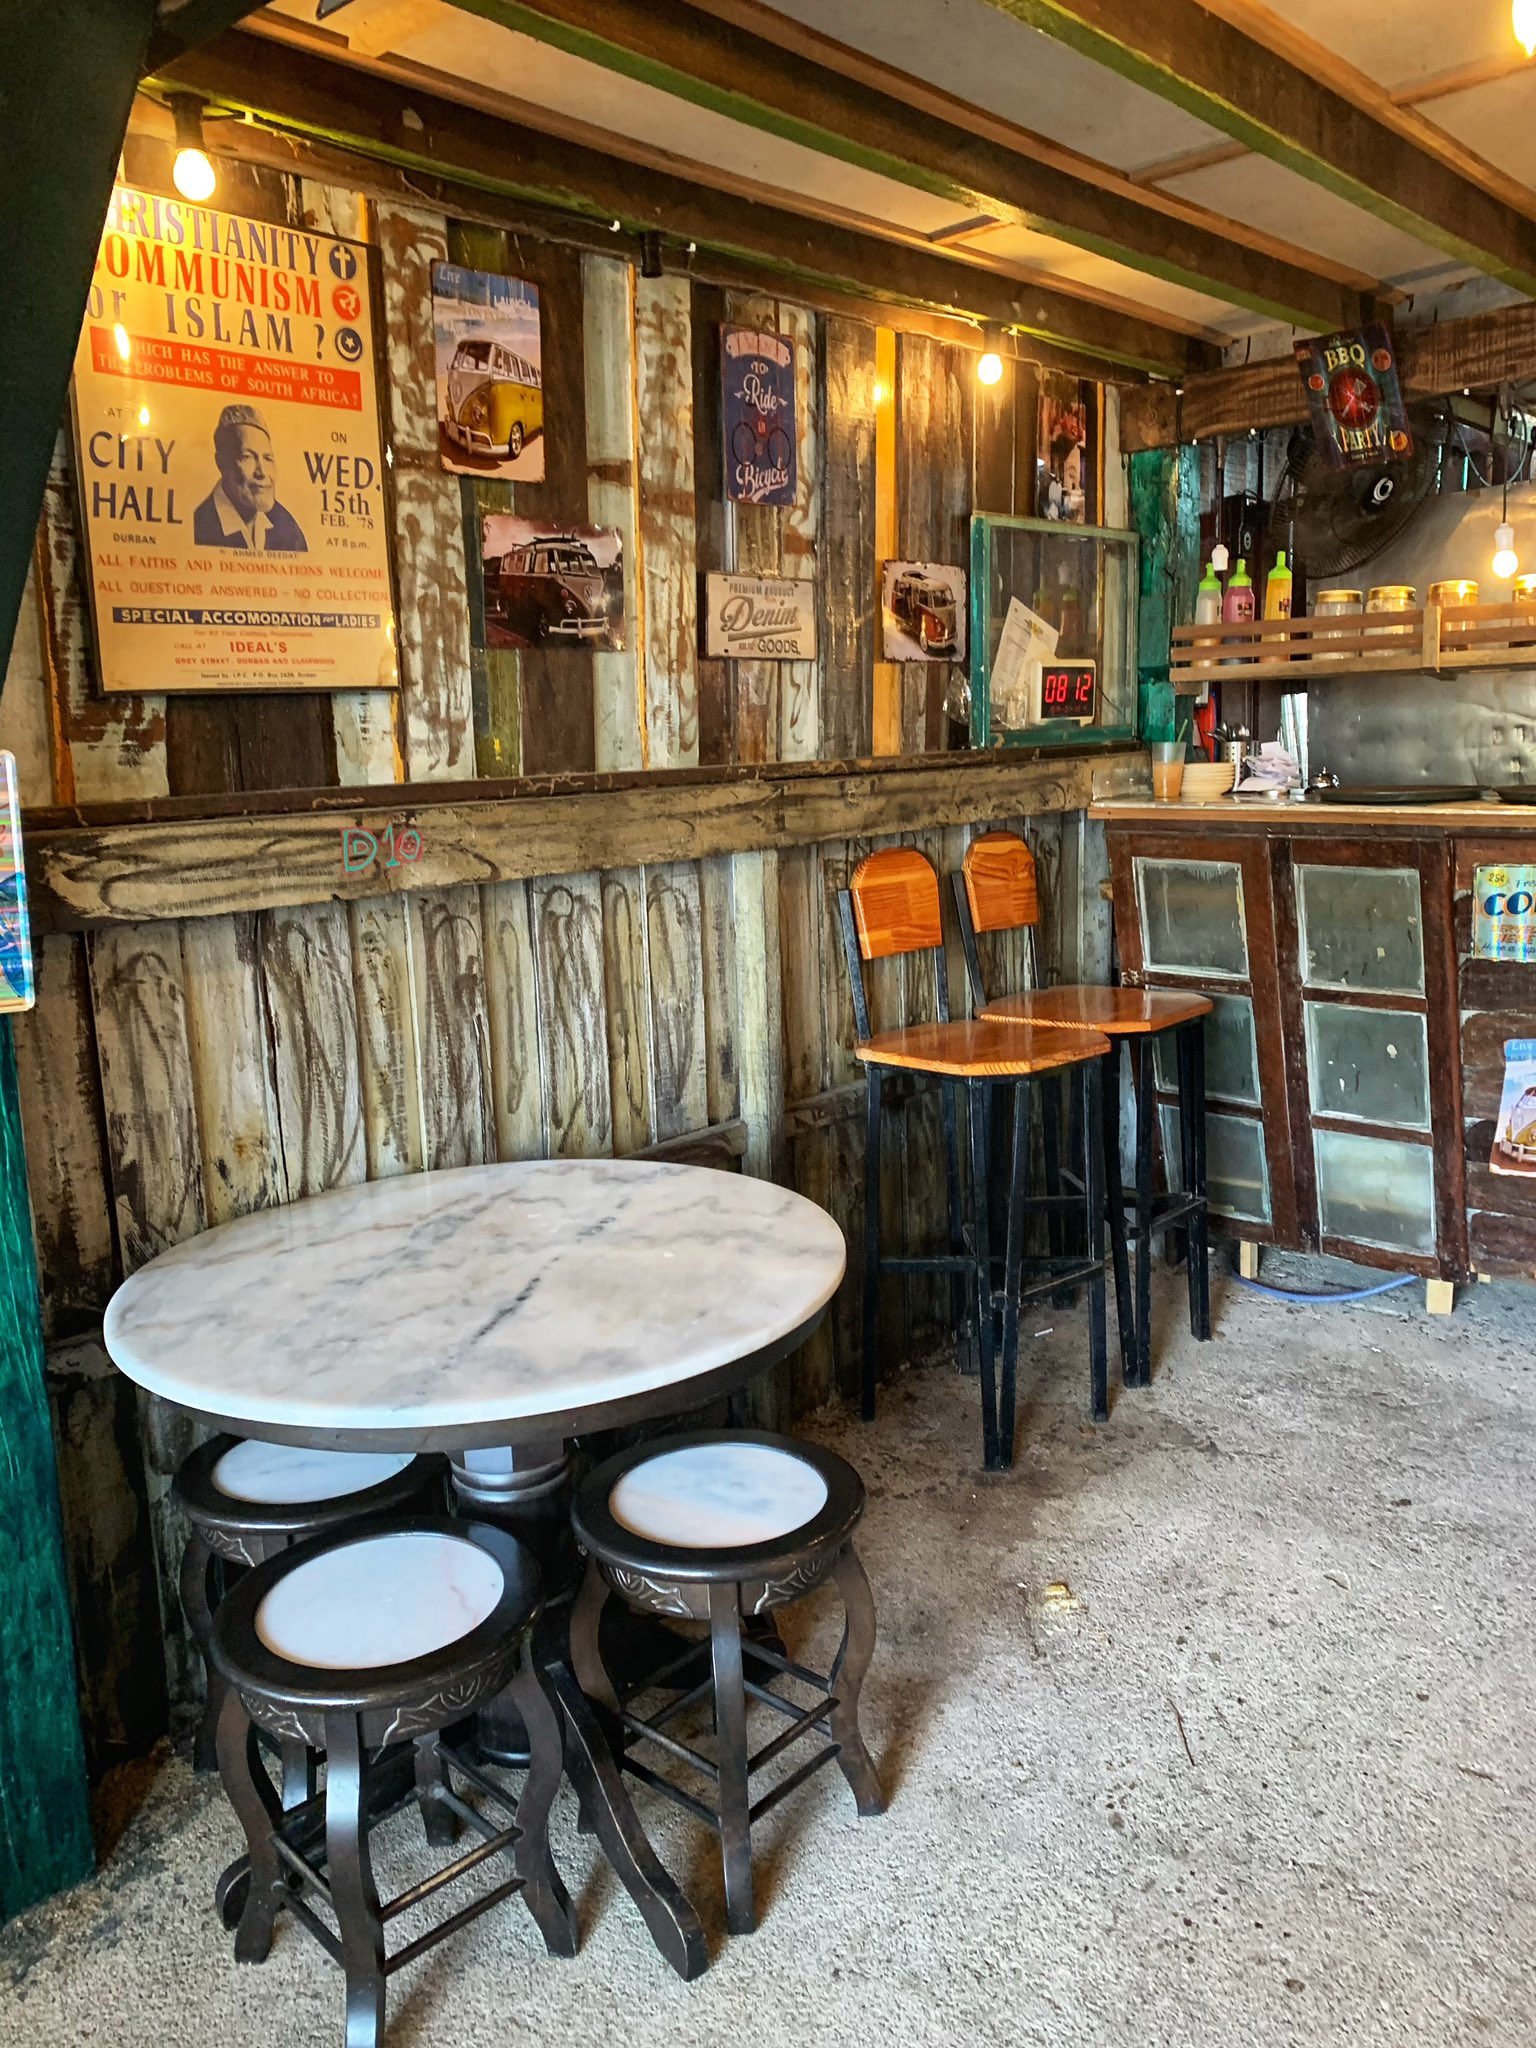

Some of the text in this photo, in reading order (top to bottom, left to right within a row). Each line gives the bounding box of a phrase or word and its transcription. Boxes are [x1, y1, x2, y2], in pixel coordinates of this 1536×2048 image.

[96, 234, 322, 318] OMMUNISM
[165, 293, 294, 353] ISLAM
[313, 323, 326, 360] ?
[181, 347, 210, 365] HAS
[216, 354, 246, 372] THE
[253, 360, 309, 381] ANSWER
[317, 370, 334, 385] TO
[1324, 344, 1365, 372] BBQ
[136, 361, 214, 385] PROBLEMS
[221, 375, 239, 389] OF
[247, 377, 293, 398] SOUTH
[301, 386, 350, 405] AFRICA
[743, 374, 777, 415] Ride
[107, 407, 123, 418] AT
[330, 431, 347, 444] ON
[1340, 418, 1380, 452] PARTY
[89, 431, 175, 474] CITY
[303, 451, 381, 491] WED.
[736, 456, 788, 501] Bicycle
[92, 481, 183, 524] HALL
[319, 489, 370, 516] 15th
[320, 513, 349, 529] FEB.
[113, 533, 156, 545] DURBAN
[326, 538, 338, 547] AT
[342, 538, 348, 547] 8
[97, 554, 385, 579] ALL FAITHS AND DENOMINATIONS WELCOME
[98, 580, 122, 593] ALL
[130, 582, 203, 595] QUESTIONS
[211, 585, 278, 598] ANSWERED
[294, 588, 311, 599] NO
[317, 590, 389, 602] COLLECTION
[729, 583, 794, 597] PREMIUM PRODUCT
[121, 609, 194, 623] SPECIAL
[202, 611, 321, 626] ACCOMODATION
[335, 615, 376, 628] LADIES
[720, 595, 798, 632] Denim
[230, 640, 287, 653] IDEAL'S
[1488, 873, 1505, 883] 25¢
